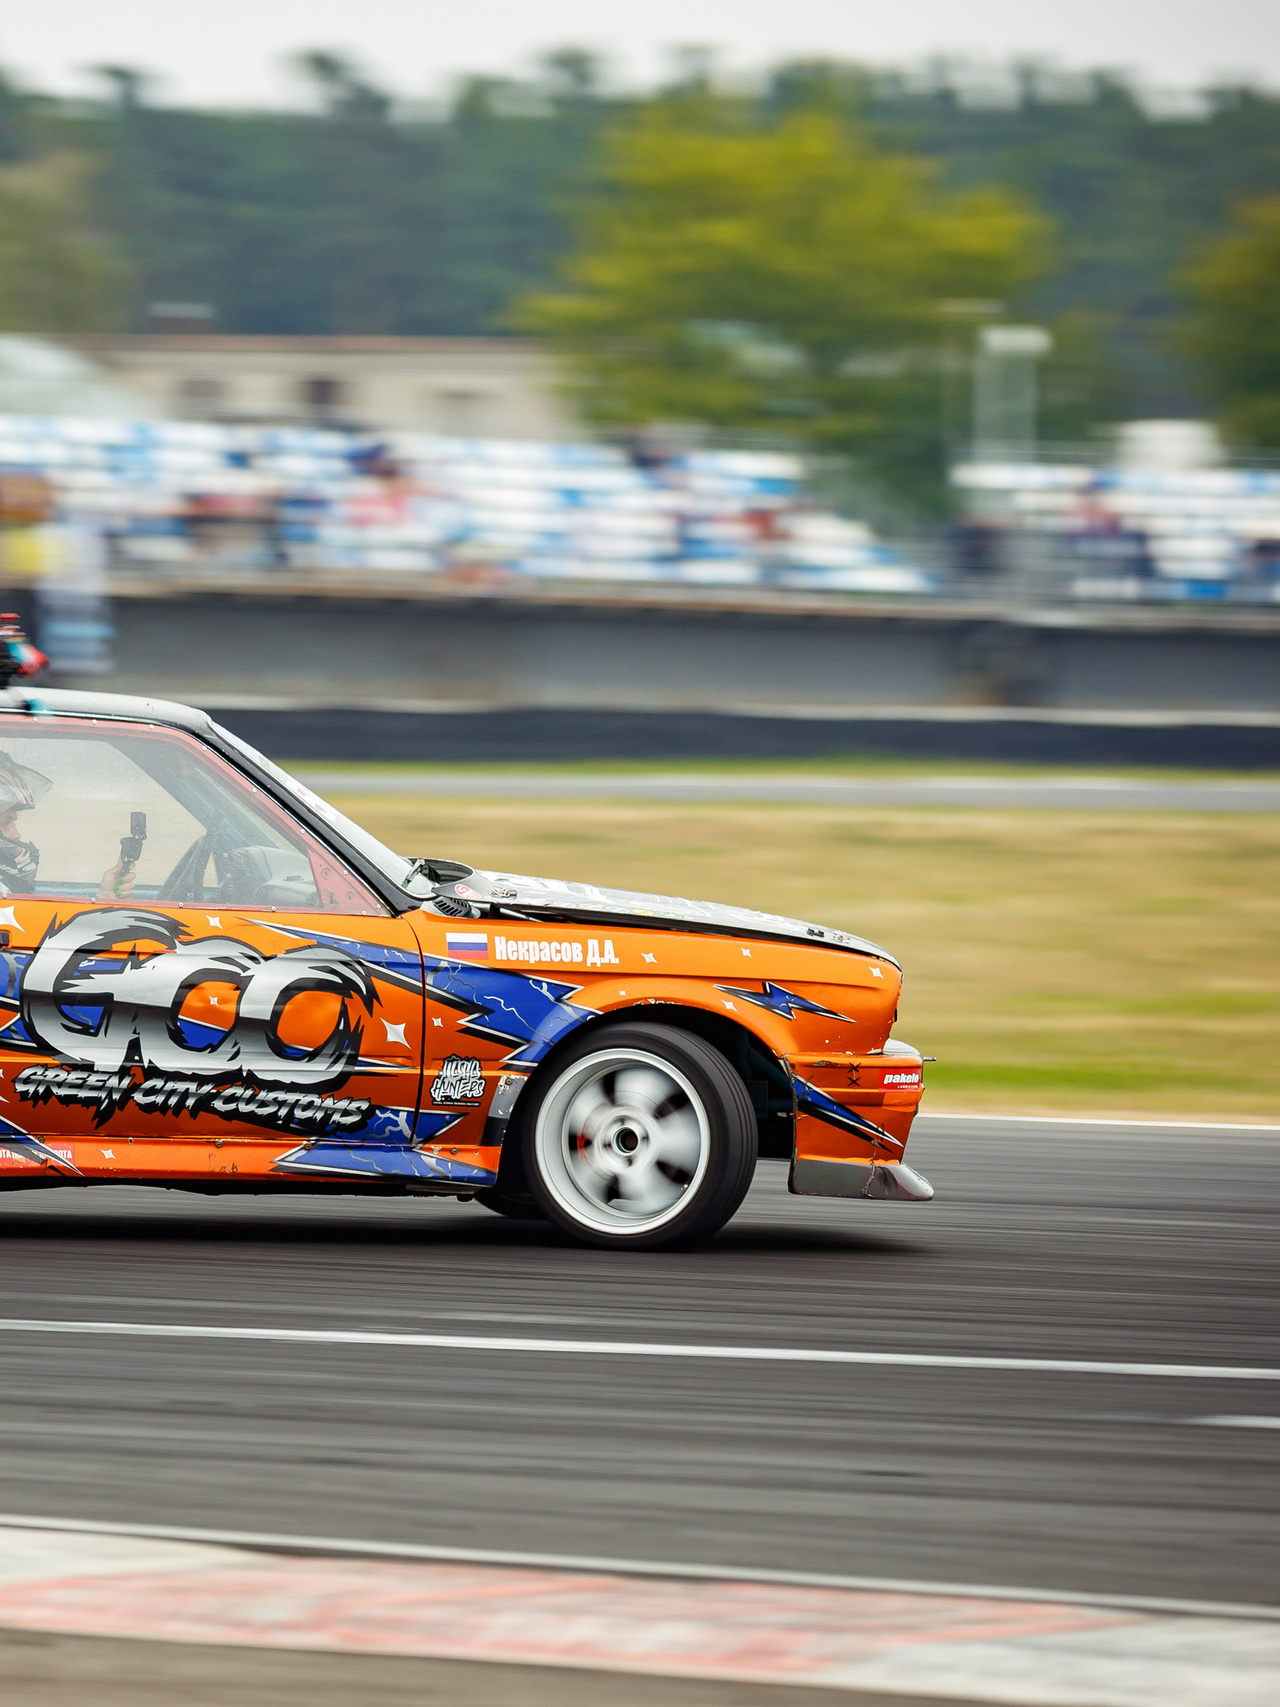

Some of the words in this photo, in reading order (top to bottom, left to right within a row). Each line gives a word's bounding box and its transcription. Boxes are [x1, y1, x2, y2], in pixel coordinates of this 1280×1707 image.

[494, 936, 583, 964] Некрасов
[586, 939, 620, 967] Д.А.
[883, 1073, 920, 1084] pakelo
[14, 1065, 133, 1103] GREEN
[133, 1077, 211, 1109] CITY
[211, 1084, 371, 1125] CUSTOMS
